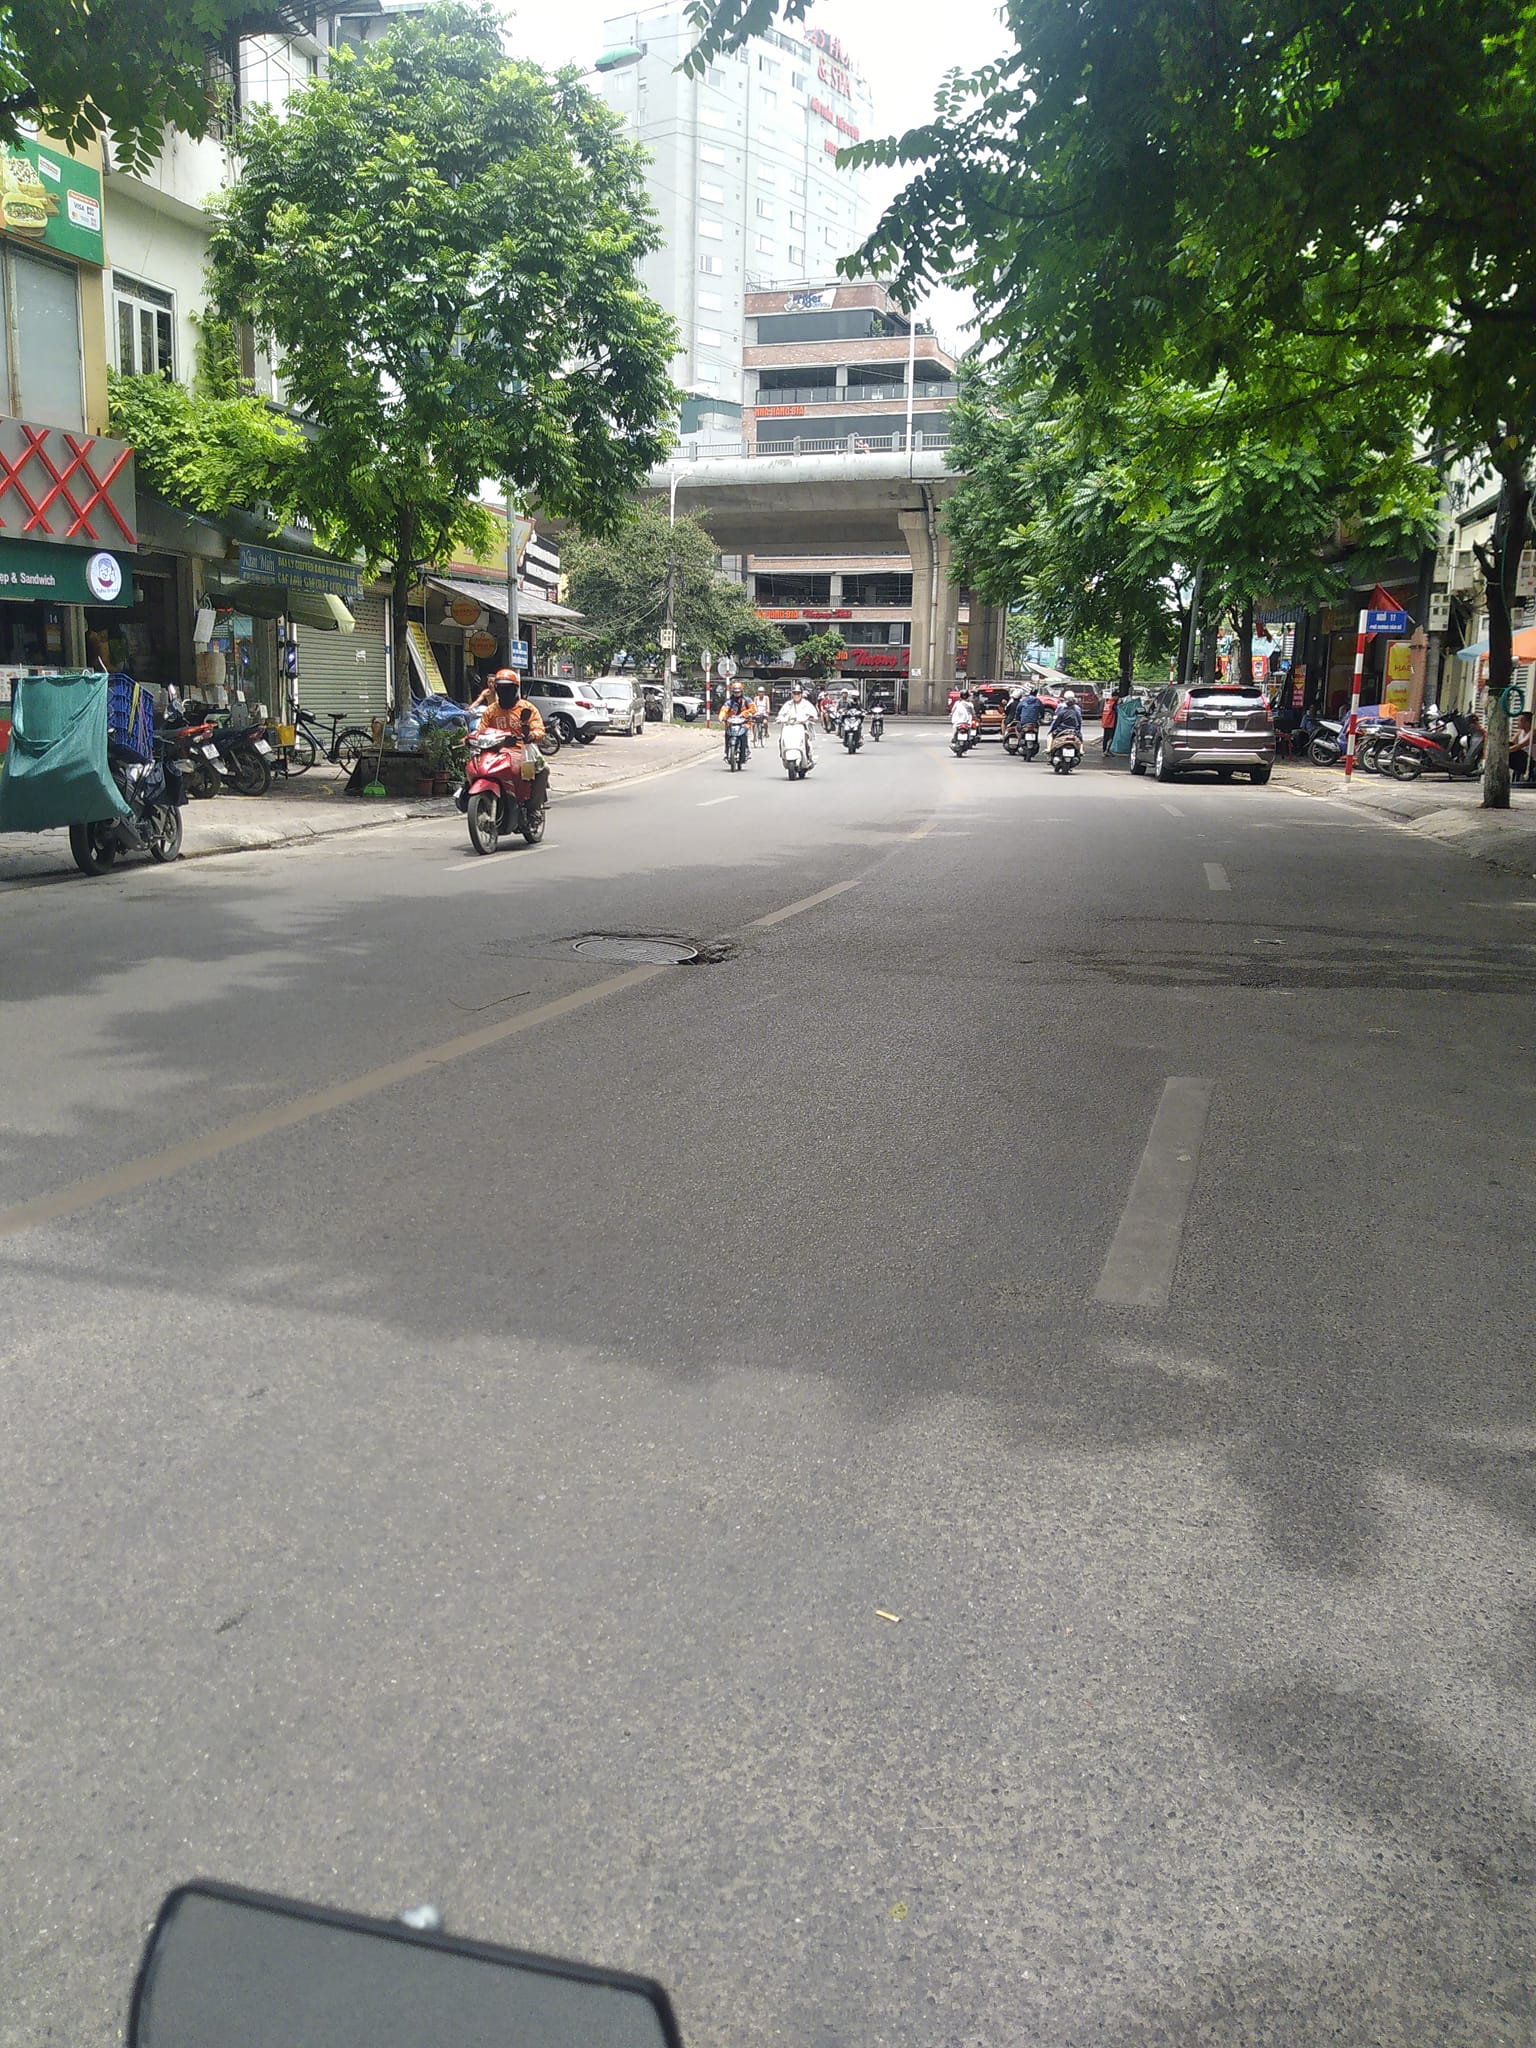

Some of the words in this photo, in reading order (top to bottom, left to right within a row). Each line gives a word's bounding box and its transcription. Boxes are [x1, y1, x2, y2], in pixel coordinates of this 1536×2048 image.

[831, 65, 851, 100] SPA
[73, 201, 85, 211] VISA
[794, 293, 823, 308] Tiger
[11, 572, 18, 584] &
[20, 572, 56, 586] Sandwich
[851, 648, 897, 669] Thượng
